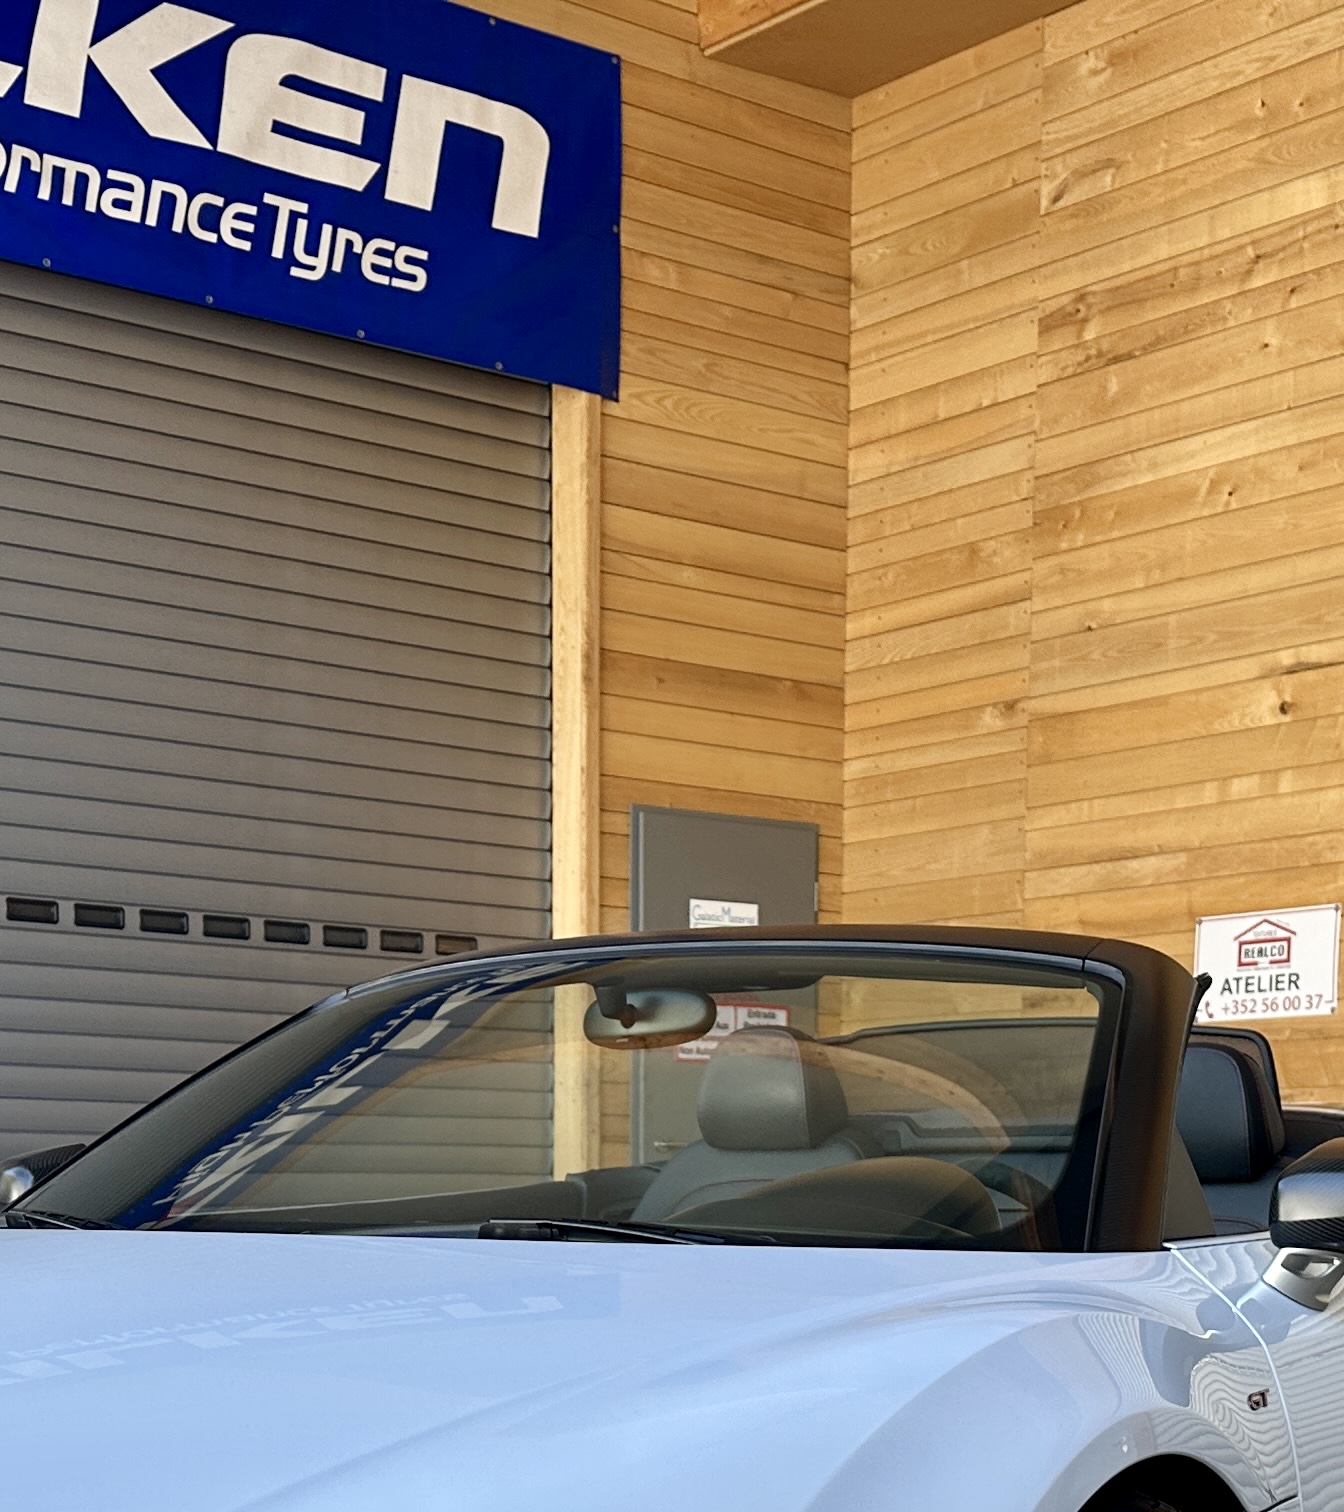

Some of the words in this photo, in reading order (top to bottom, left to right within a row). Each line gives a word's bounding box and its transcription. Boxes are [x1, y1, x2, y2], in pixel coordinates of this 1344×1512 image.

[262, 192, 430, 293] Tyres
[1220, 973, 1301, 996] ATELIER
[1222, 998, 1257, 1015] +352
[1261, 997, 1279, 1013] 56
[1283, 995, 1301, 1011] 00
[1305, 994, 1323, 1010] 37
